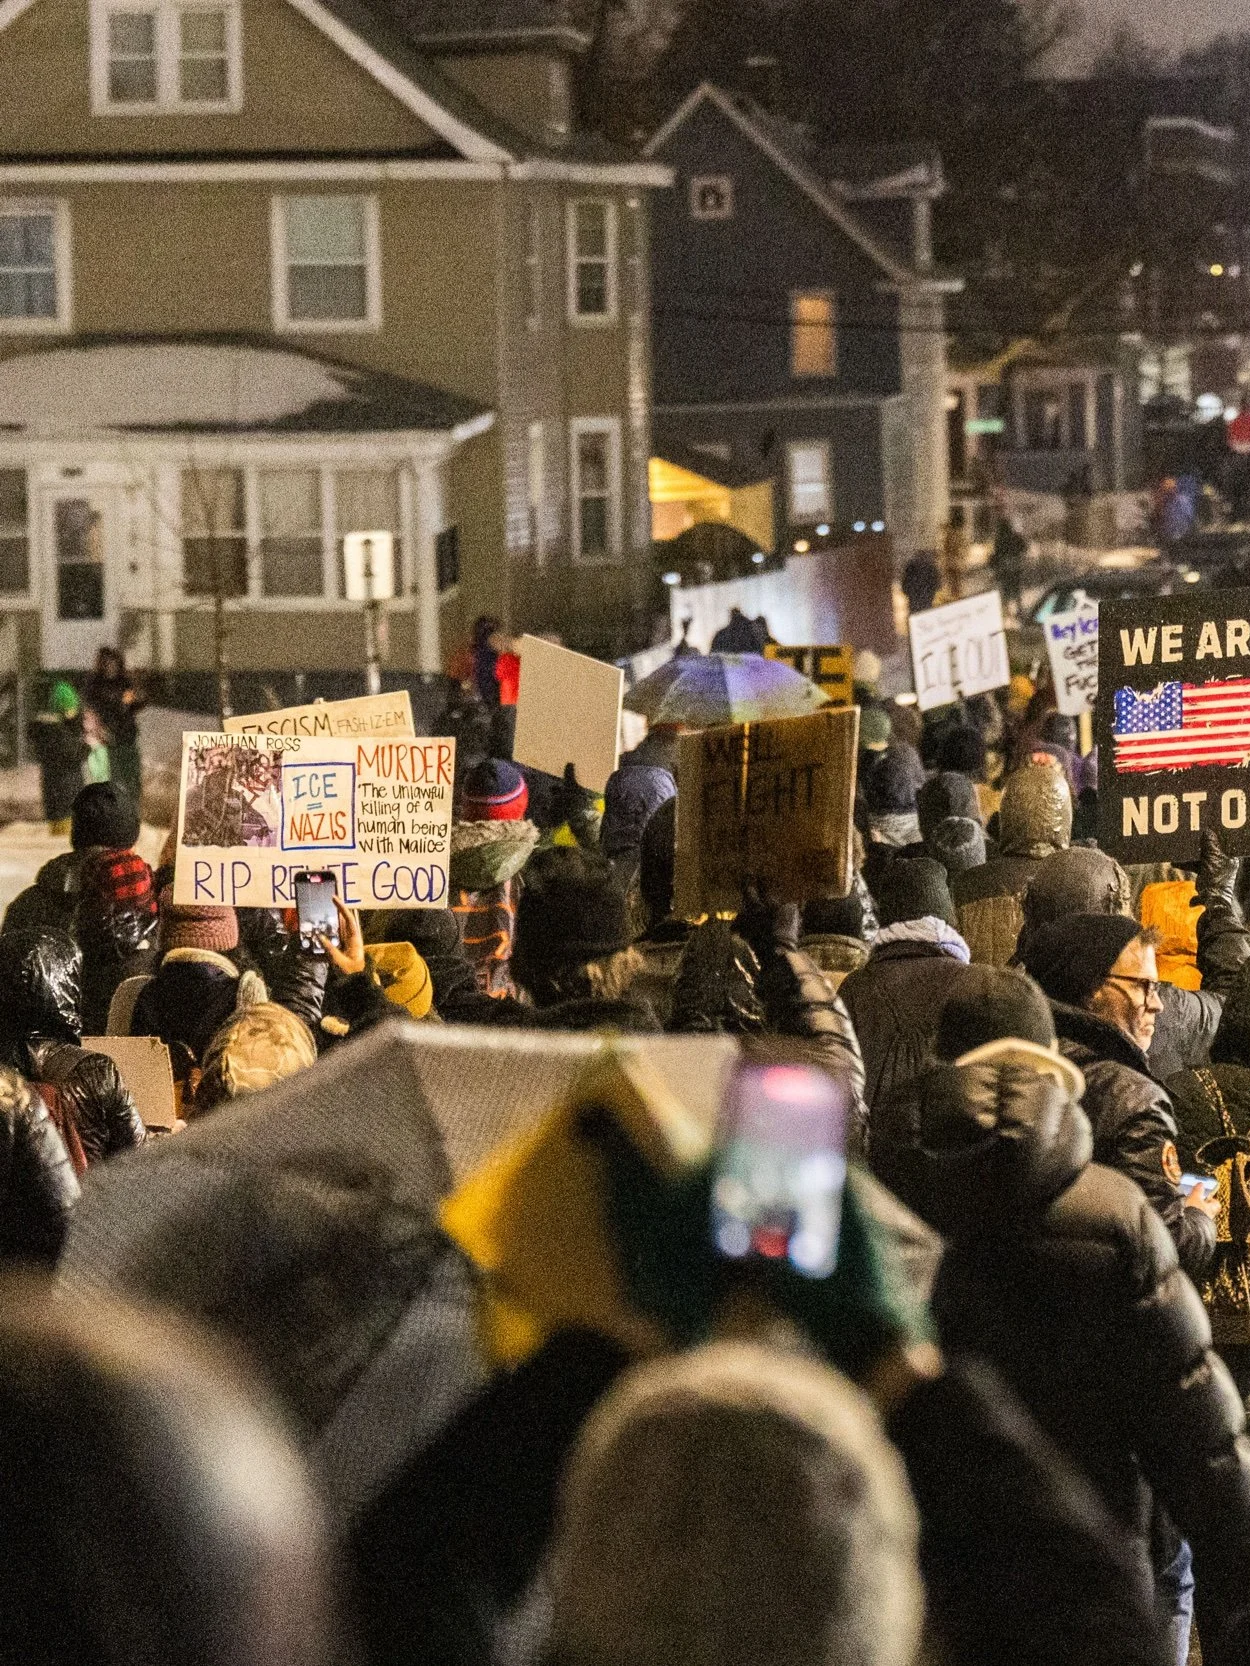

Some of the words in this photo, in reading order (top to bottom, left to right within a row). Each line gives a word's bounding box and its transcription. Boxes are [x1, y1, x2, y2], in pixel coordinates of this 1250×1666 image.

[1119, 624, 1184, 667] WE
[1065, 674, 1098, 696] FUC
[194, 733, 258, 749] JONATHAN
[266, 737, 301, 752] ROSS
[356, 744, 452, 785] MURDER:
[292, 772, 338, 799] ICE
[290, 811, 347, 841] NAZIS
[357, 818, 405, 835] human
[411, 819, 448, 839] being
[1122, 792, 1208, 837] NOT
[194, 861, 252, 905] RIP
[272, 862, 362, 904] REE
[372, 861, 446, 903] GOOD
